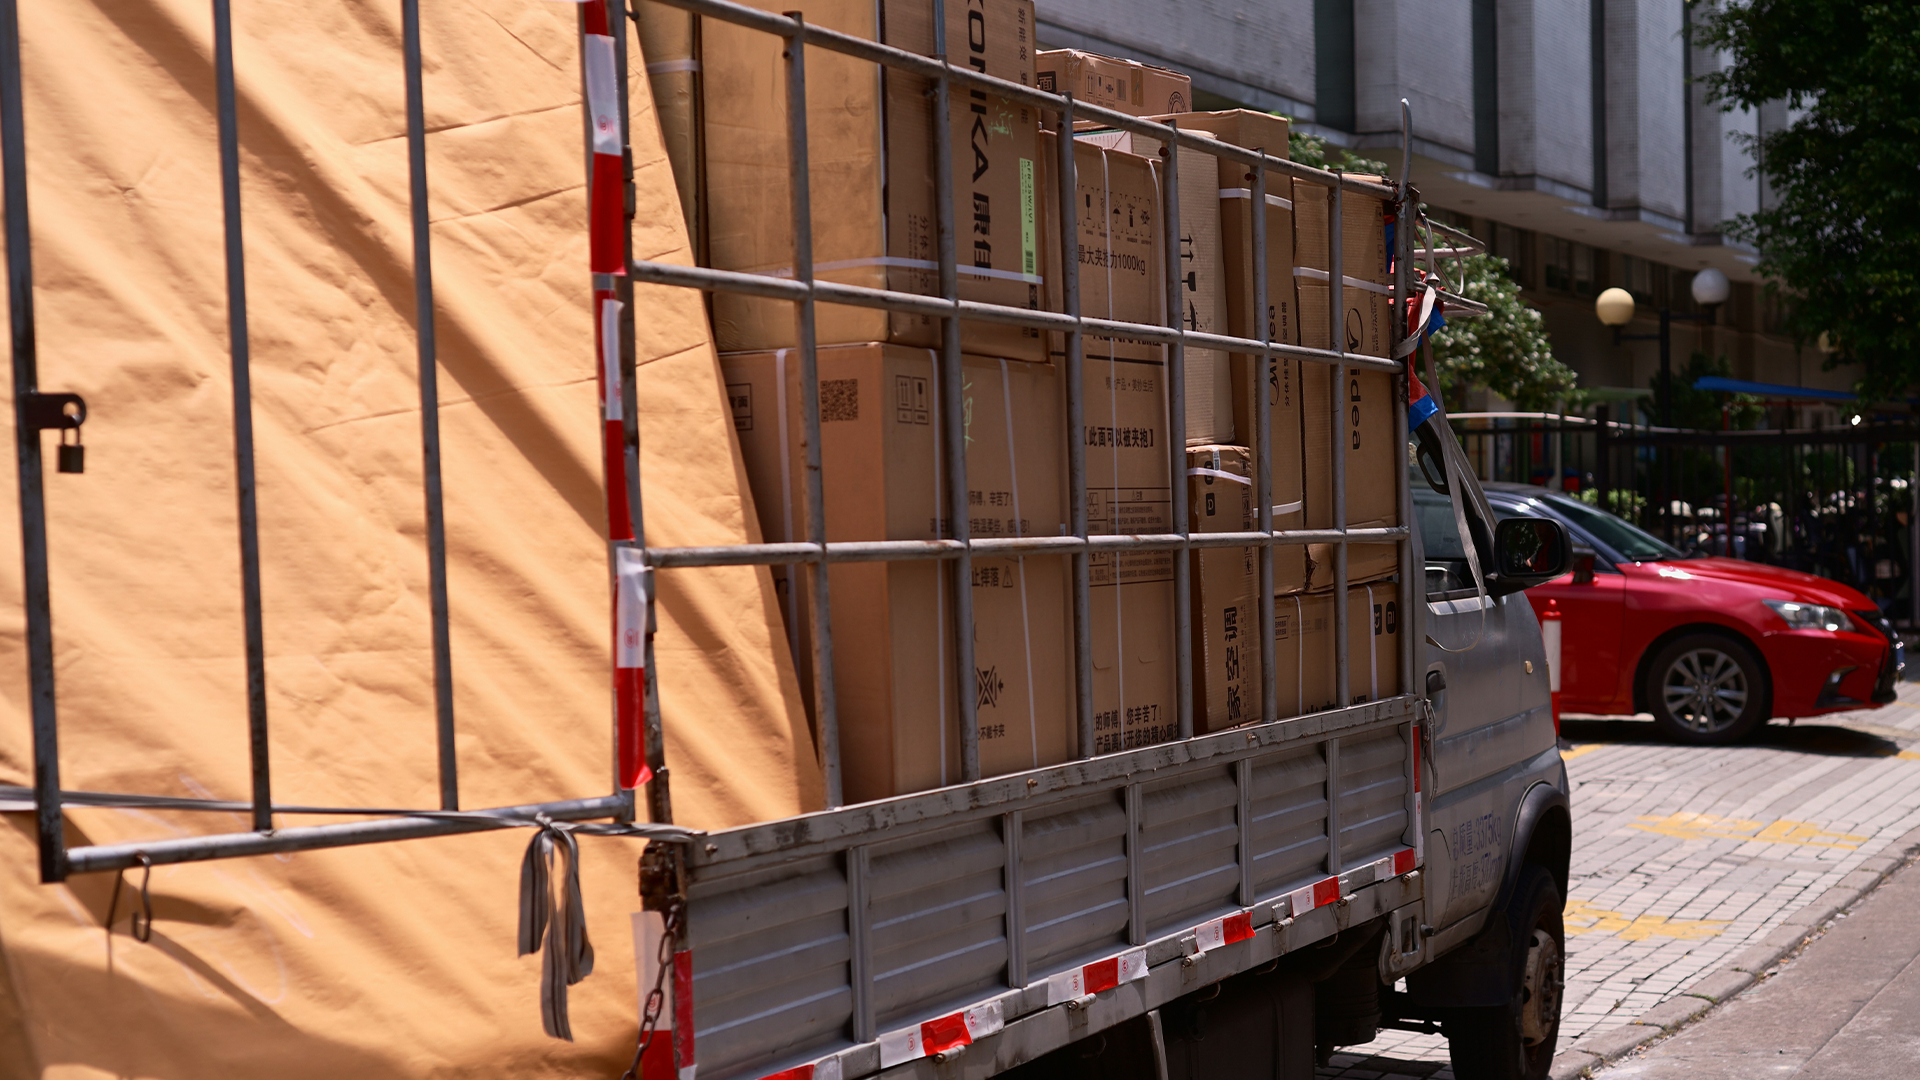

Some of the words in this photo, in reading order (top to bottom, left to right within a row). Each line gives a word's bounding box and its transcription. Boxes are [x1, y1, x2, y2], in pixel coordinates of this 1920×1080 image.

[1016, 8, 1028, 61] 新能效
[967, 0, 989, 183] ONKA
[1019, 71, 1029, 124] 更能
[973, 192, 992, 281] 康佳
[1268, 304, 1279, 406] Miea
[1223, 606, 1241, 721] 家空调
[977, 723, 1005, 740] 不能卡夹
[1093, 704, 1162, 732] 的师傅，您辛苦了！
